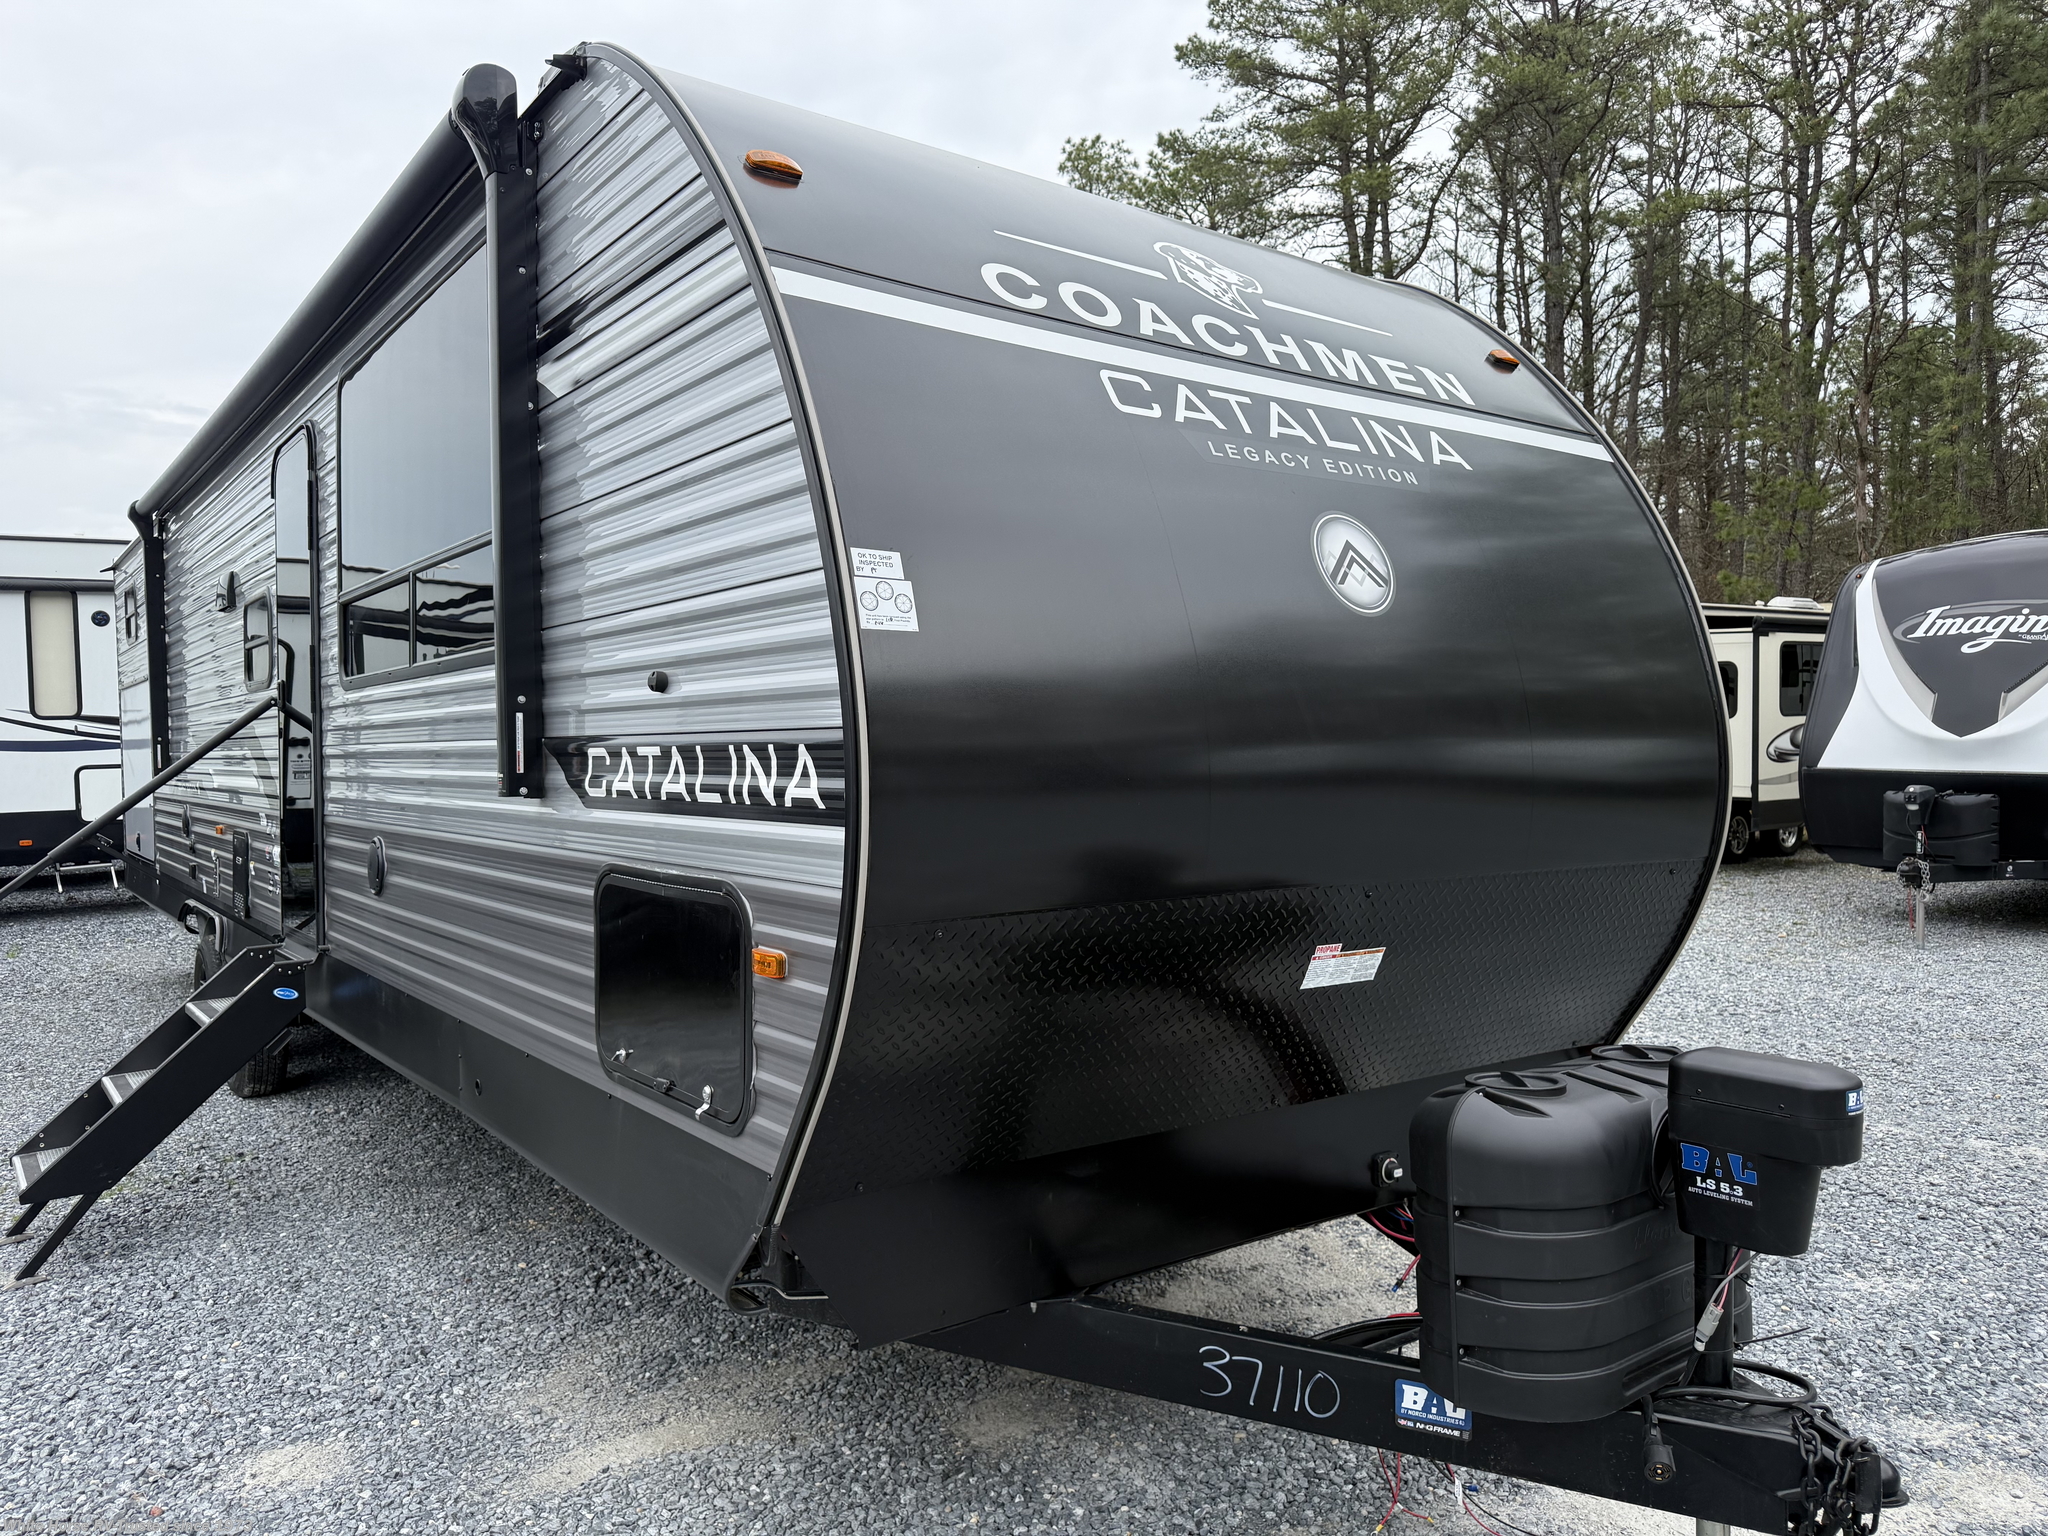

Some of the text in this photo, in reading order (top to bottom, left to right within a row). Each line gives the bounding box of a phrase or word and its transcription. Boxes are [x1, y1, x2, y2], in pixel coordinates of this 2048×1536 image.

[980, 263, 1475, 406] COACHMEN
[1100, 369, 1473, 471] CATALINA
[1208, 440, 1419, 486] LEGACY EDITION
[858, 559, 894, 568] INSPECTED
[585, 743, 826, 809] CATALINA
[1316, 945, 1341, 954] PROPANE
[1681, 1142, 1758, 1186] BAL
[1688, 1186, 1753, 1207] AUTO LEVELING SYSTEM
[1696, 1176, 1743, 1197] LS 5.3
[1199, 1345, 1340, 1418] 37110
[1401, 1384, 1466, 1420] BAL
[1408, 1410, 1426, 1418] NORCO
[1427, 1414, 1460, 1425] INDUSTRIES
[1433, 1426, 1461, 1437] FRAME
